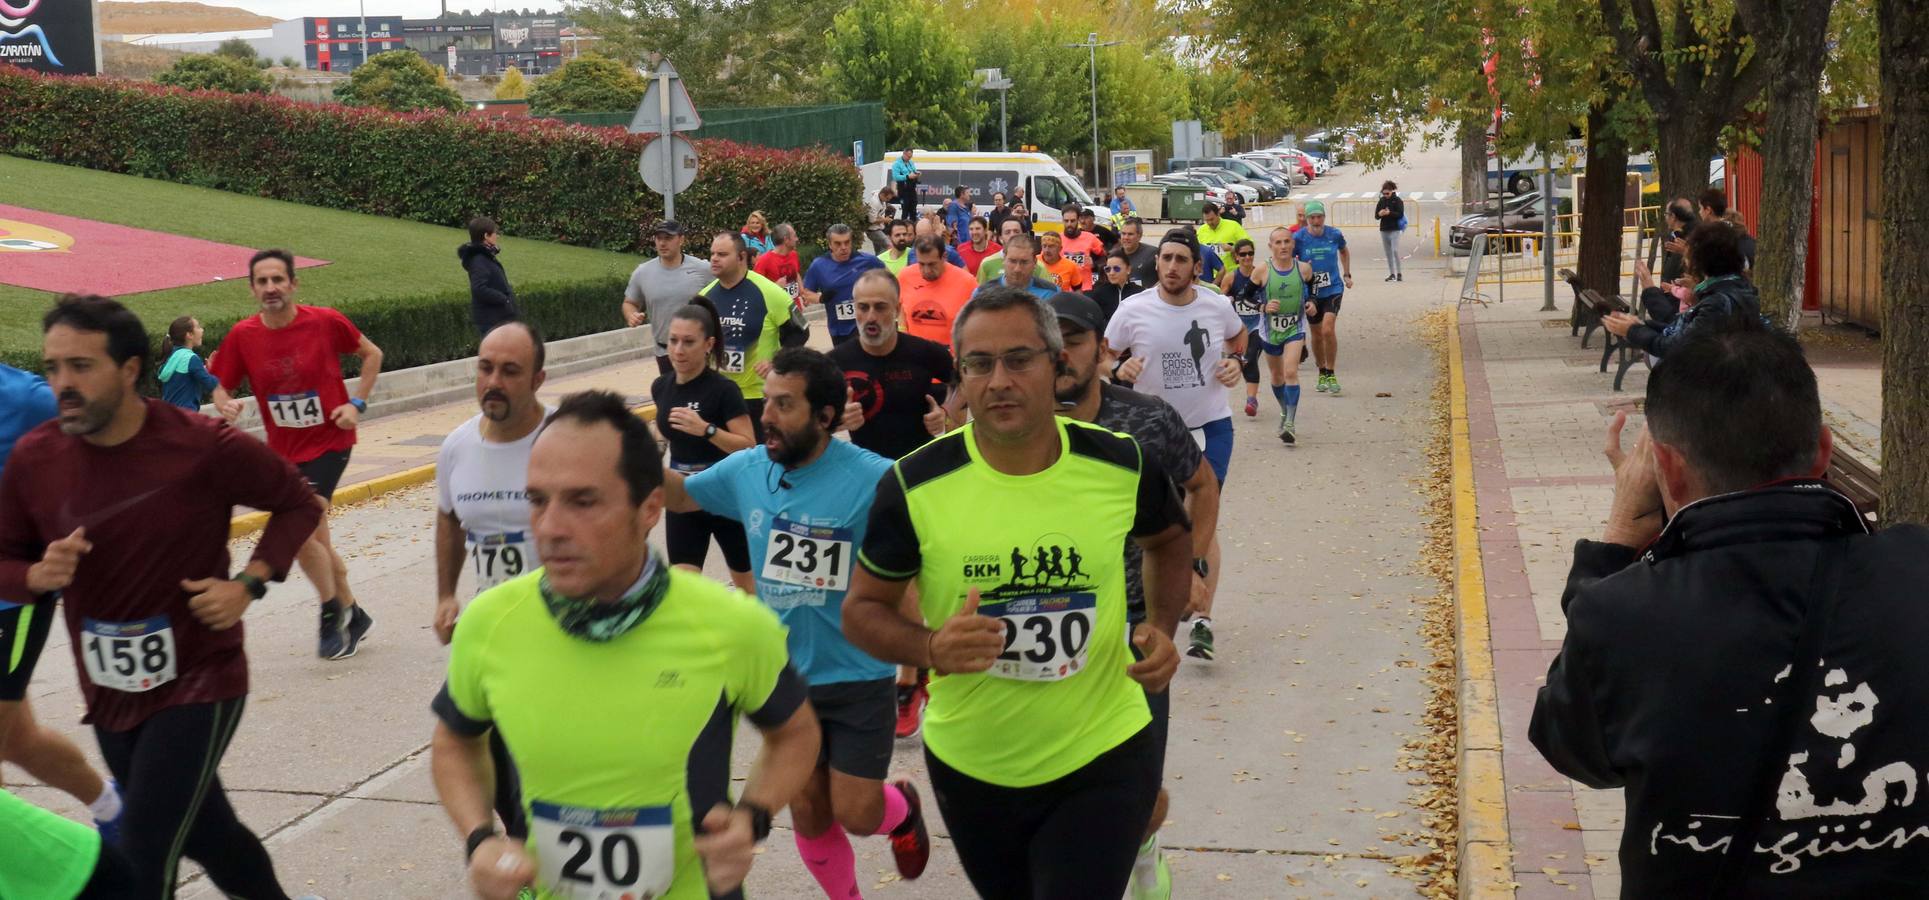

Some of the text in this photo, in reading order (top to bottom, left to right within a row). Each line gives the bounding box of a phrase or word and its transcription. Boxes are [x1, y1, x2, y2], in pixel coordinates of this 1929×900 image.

[0, 42, 42, 57] ZARATÁN
[1314, 272, 1329, 284] 24
[838, 304, 855, 316] 13
[1273, 316, 1298, 329] 104
[1162, 351, 1182, 360] XXXV
[1162, 358, 1194, 370] CROSS
[1163, 368, 1196, 377] RONDILLA
[273, 398, 319, 420] 114
[472, 544, 523, 577] 179
[770, 533, 842, 576] 231
[963, 554, 1000, 563] CARRERA
[963, 563, 1000, 578] 6KM
[998, 611, 1090, 664] 230
[89, 634, 168, 677] 158
[559, 830, 640, 887] 20
